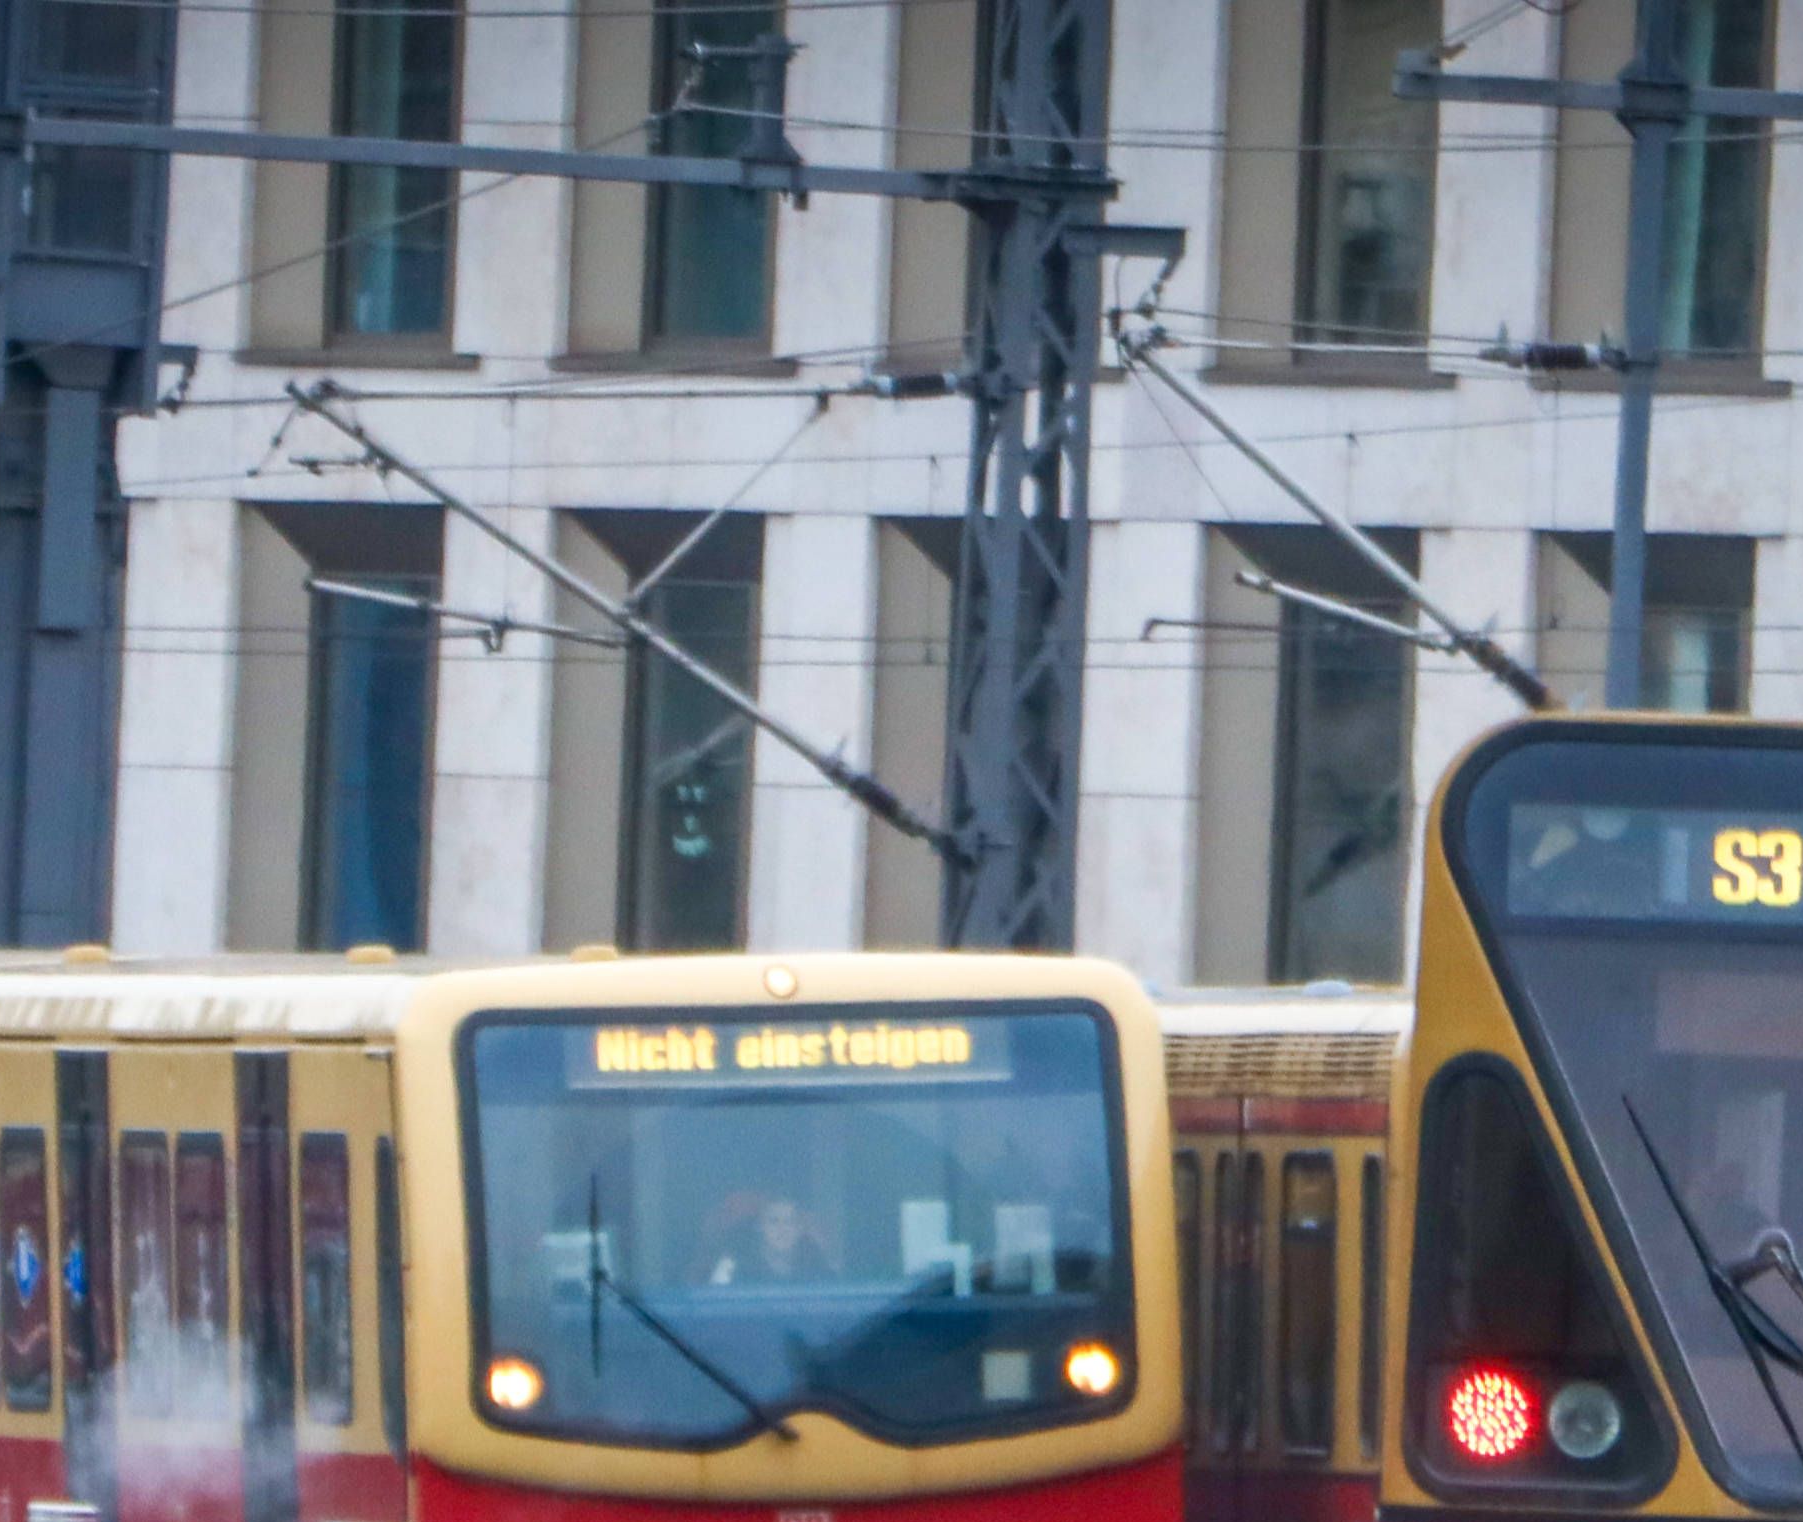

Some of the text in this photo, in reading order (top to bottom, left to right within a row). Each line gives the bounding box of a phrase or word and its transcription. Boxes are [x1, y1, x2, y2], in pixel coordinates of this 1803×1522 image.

[1712, 826, 1803, 908] S3
[597, 1021, 971, 1072] Nicht einsteigen
